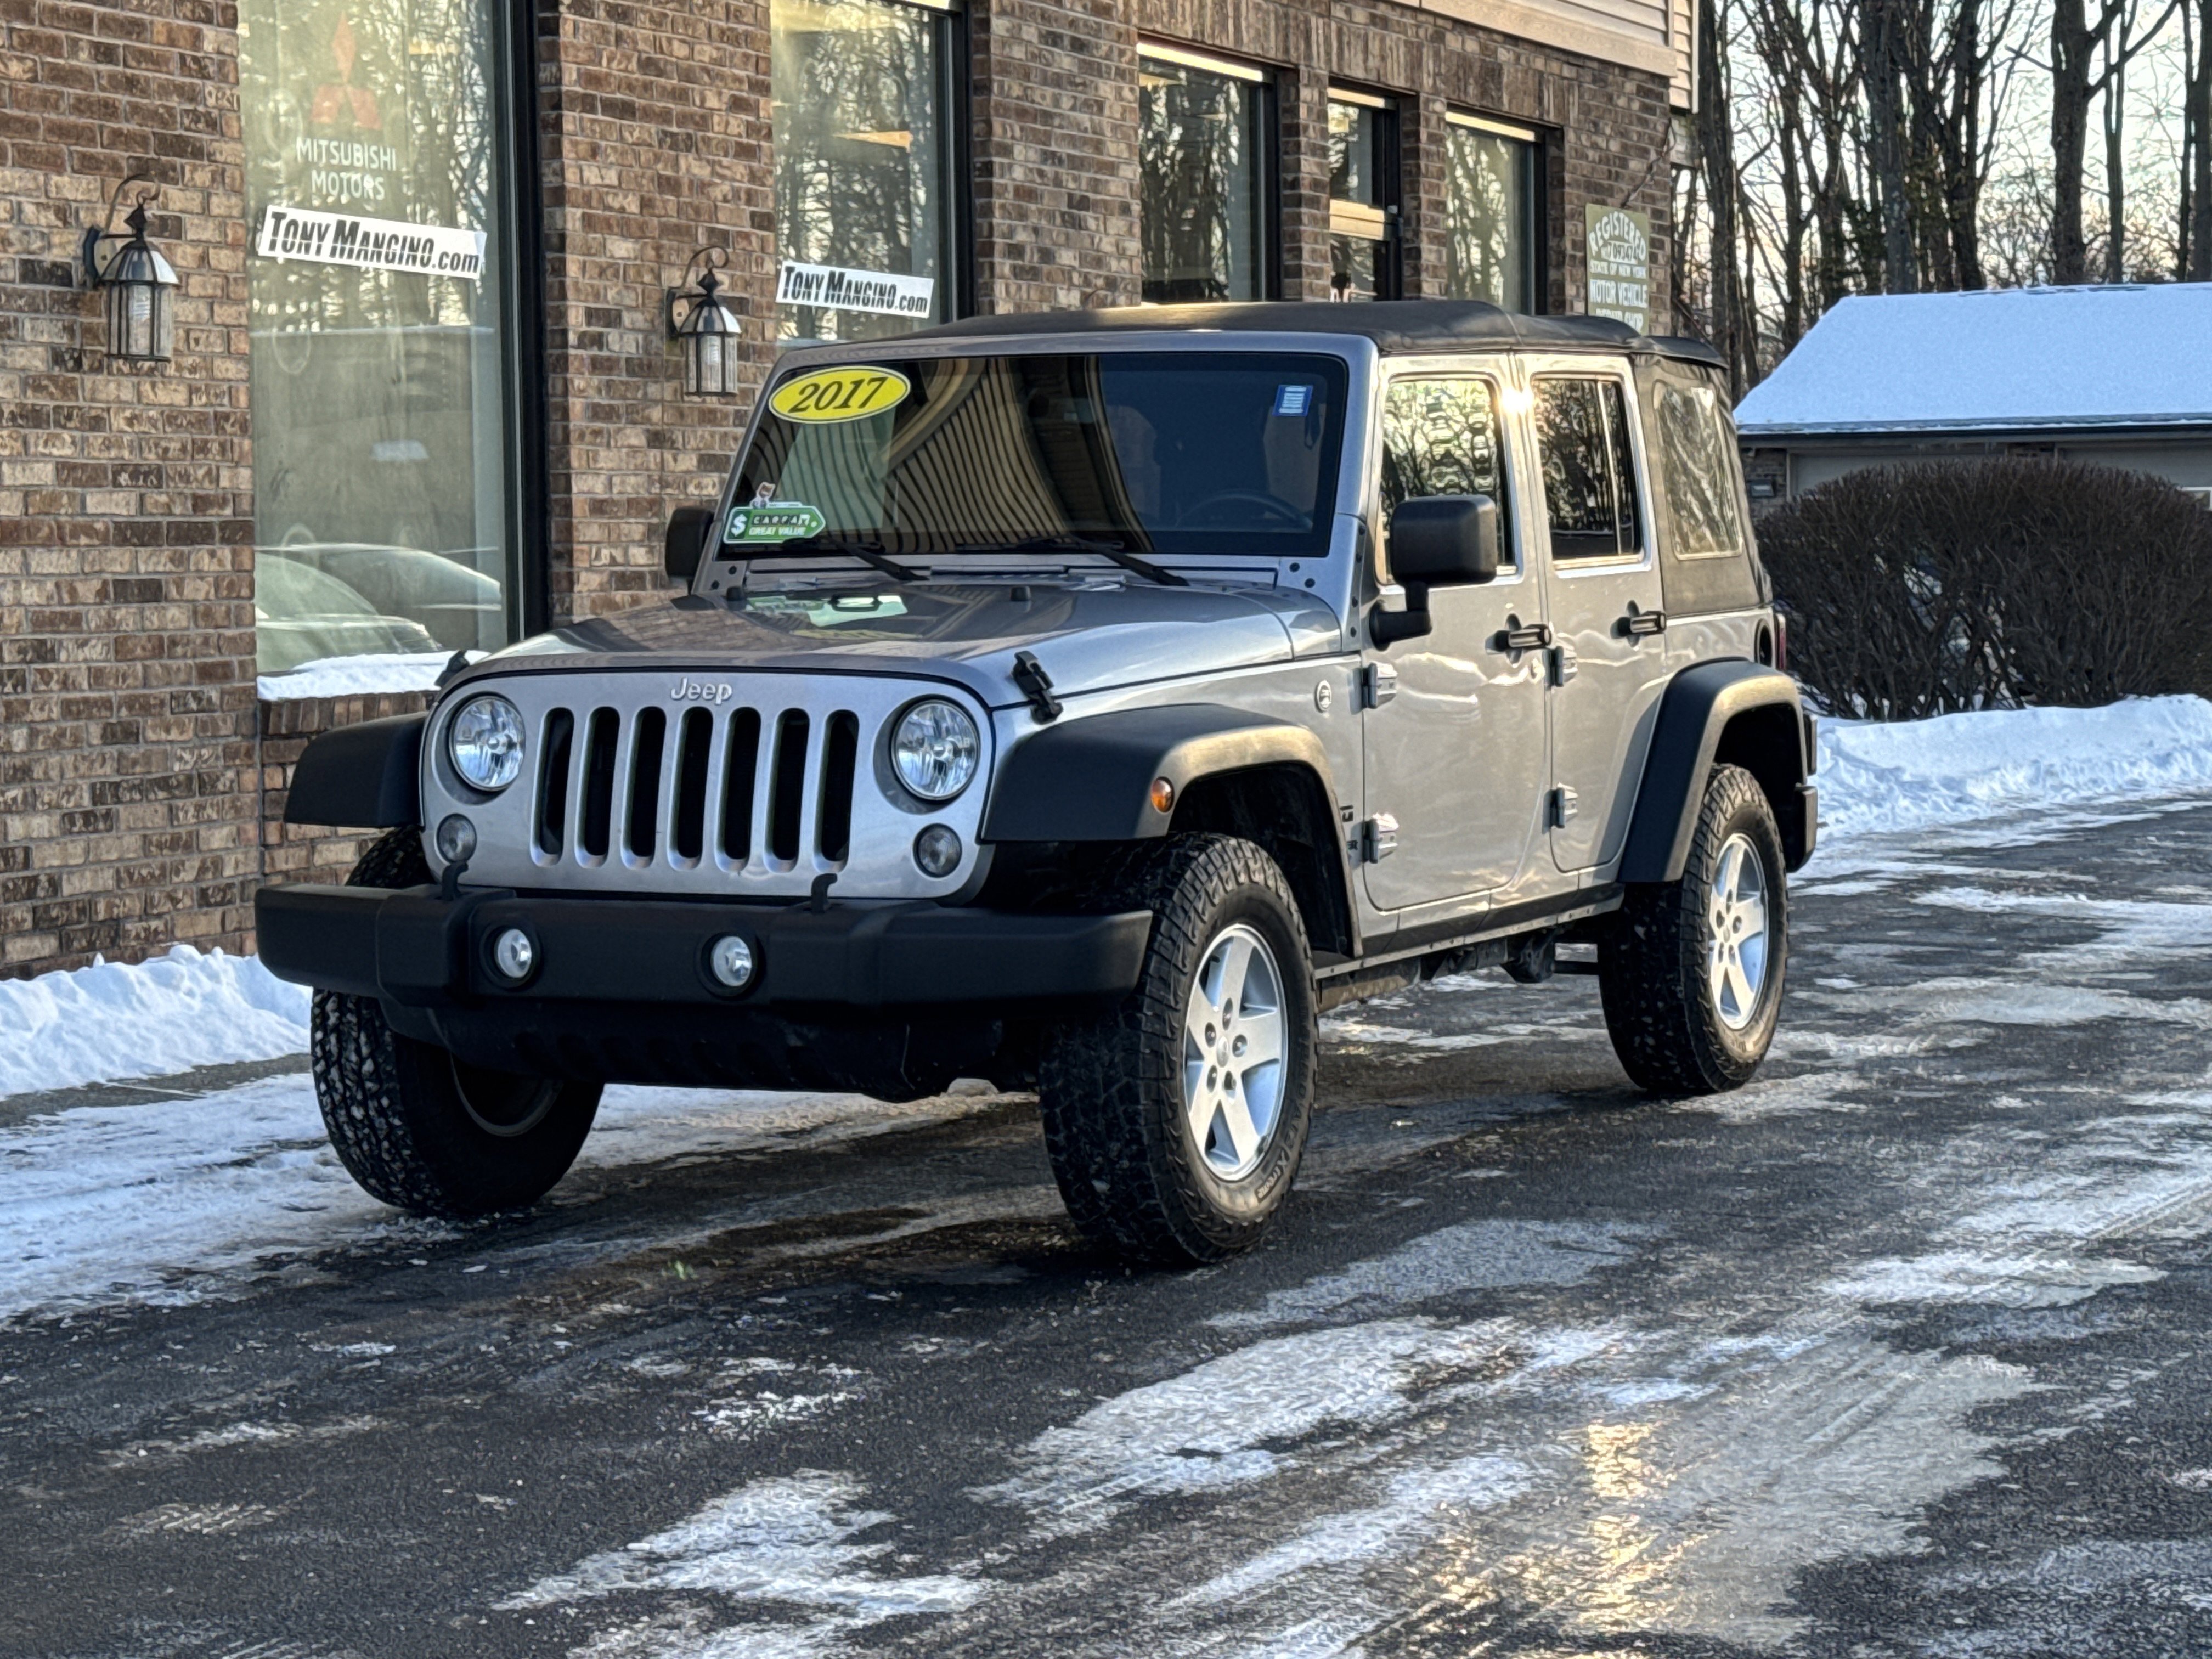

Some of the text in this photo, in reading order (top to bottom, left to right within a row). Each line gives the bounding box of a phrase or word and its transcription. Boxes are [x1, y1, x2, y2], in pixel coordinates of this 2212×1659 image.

[296, 136, 397, 172] MITSUBISHI
[311, 169, 385, 201] MOTORS
[1588, 210, 1646, 261] REGISTERED
[1590, 279, 1648, 308] MOTOR VEHICLE
[787, 376, 889, 413] 2017
[671, 677, 732, 705] Jeep
